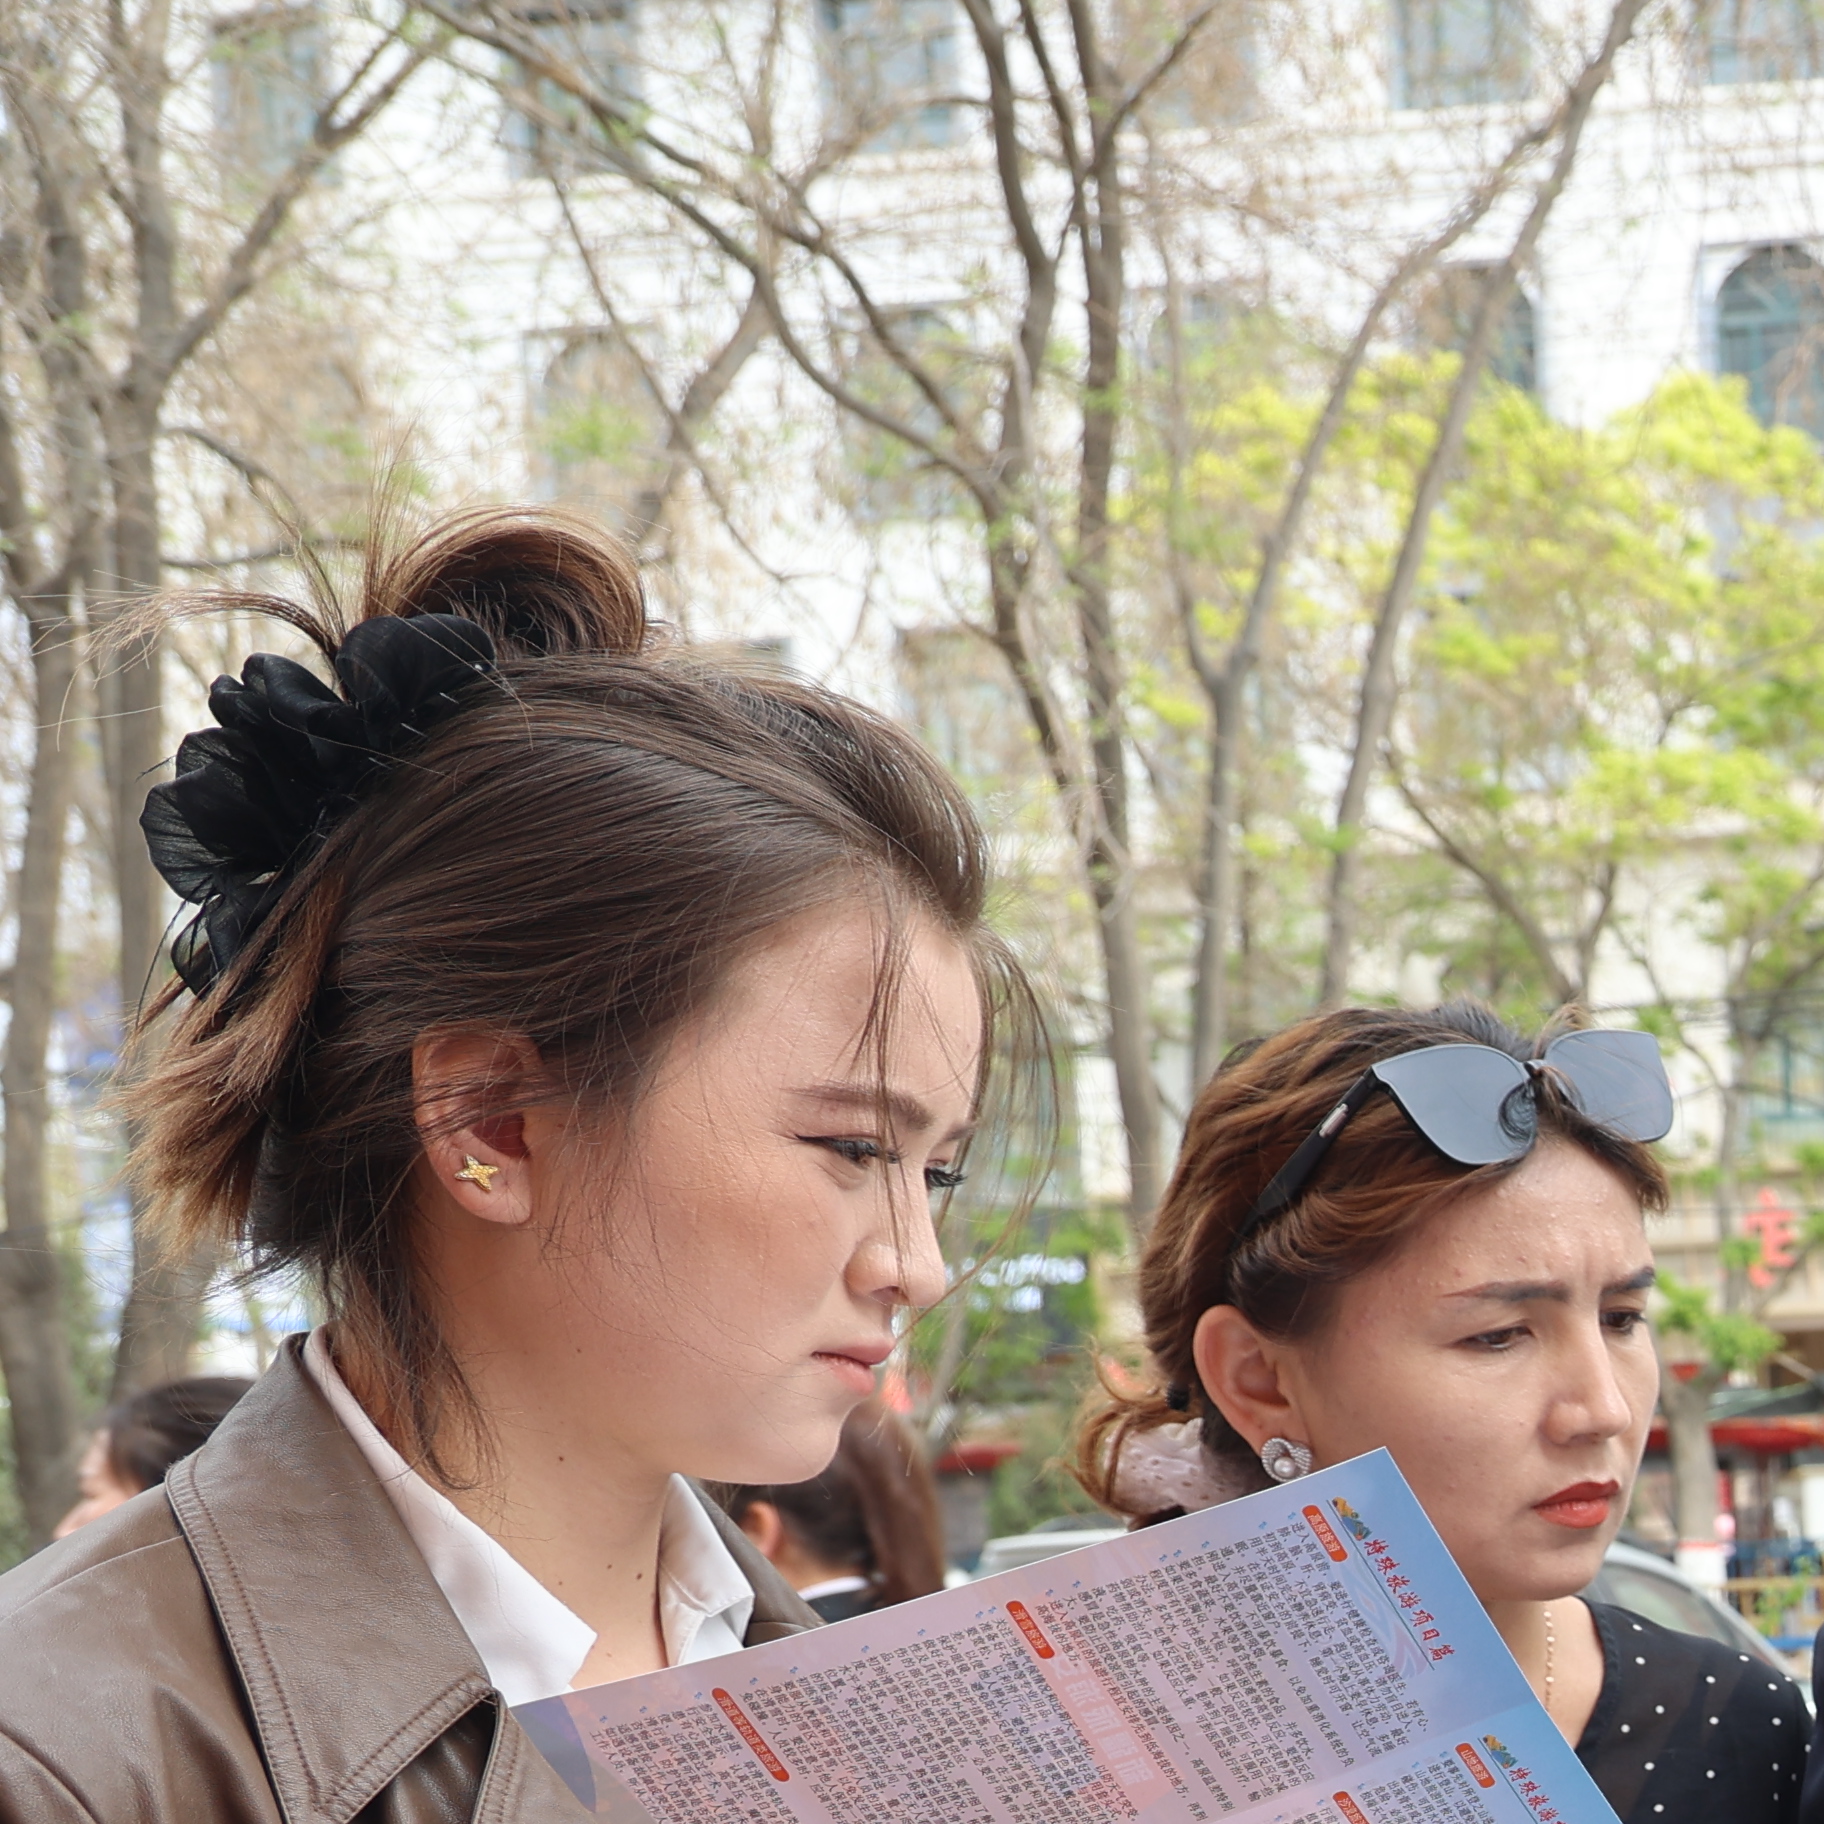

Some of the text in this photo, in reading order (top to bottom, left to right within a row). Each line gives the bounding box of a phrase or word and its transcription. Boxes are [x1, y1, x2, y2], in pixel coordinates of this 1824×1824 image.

[1305, 1512, 1341, 1553] 高原旅游
[1359, 1536, 1456, 1662] 特殊旅游项目篇
[1456, 1748, 1491, 1782] 山地旅游
